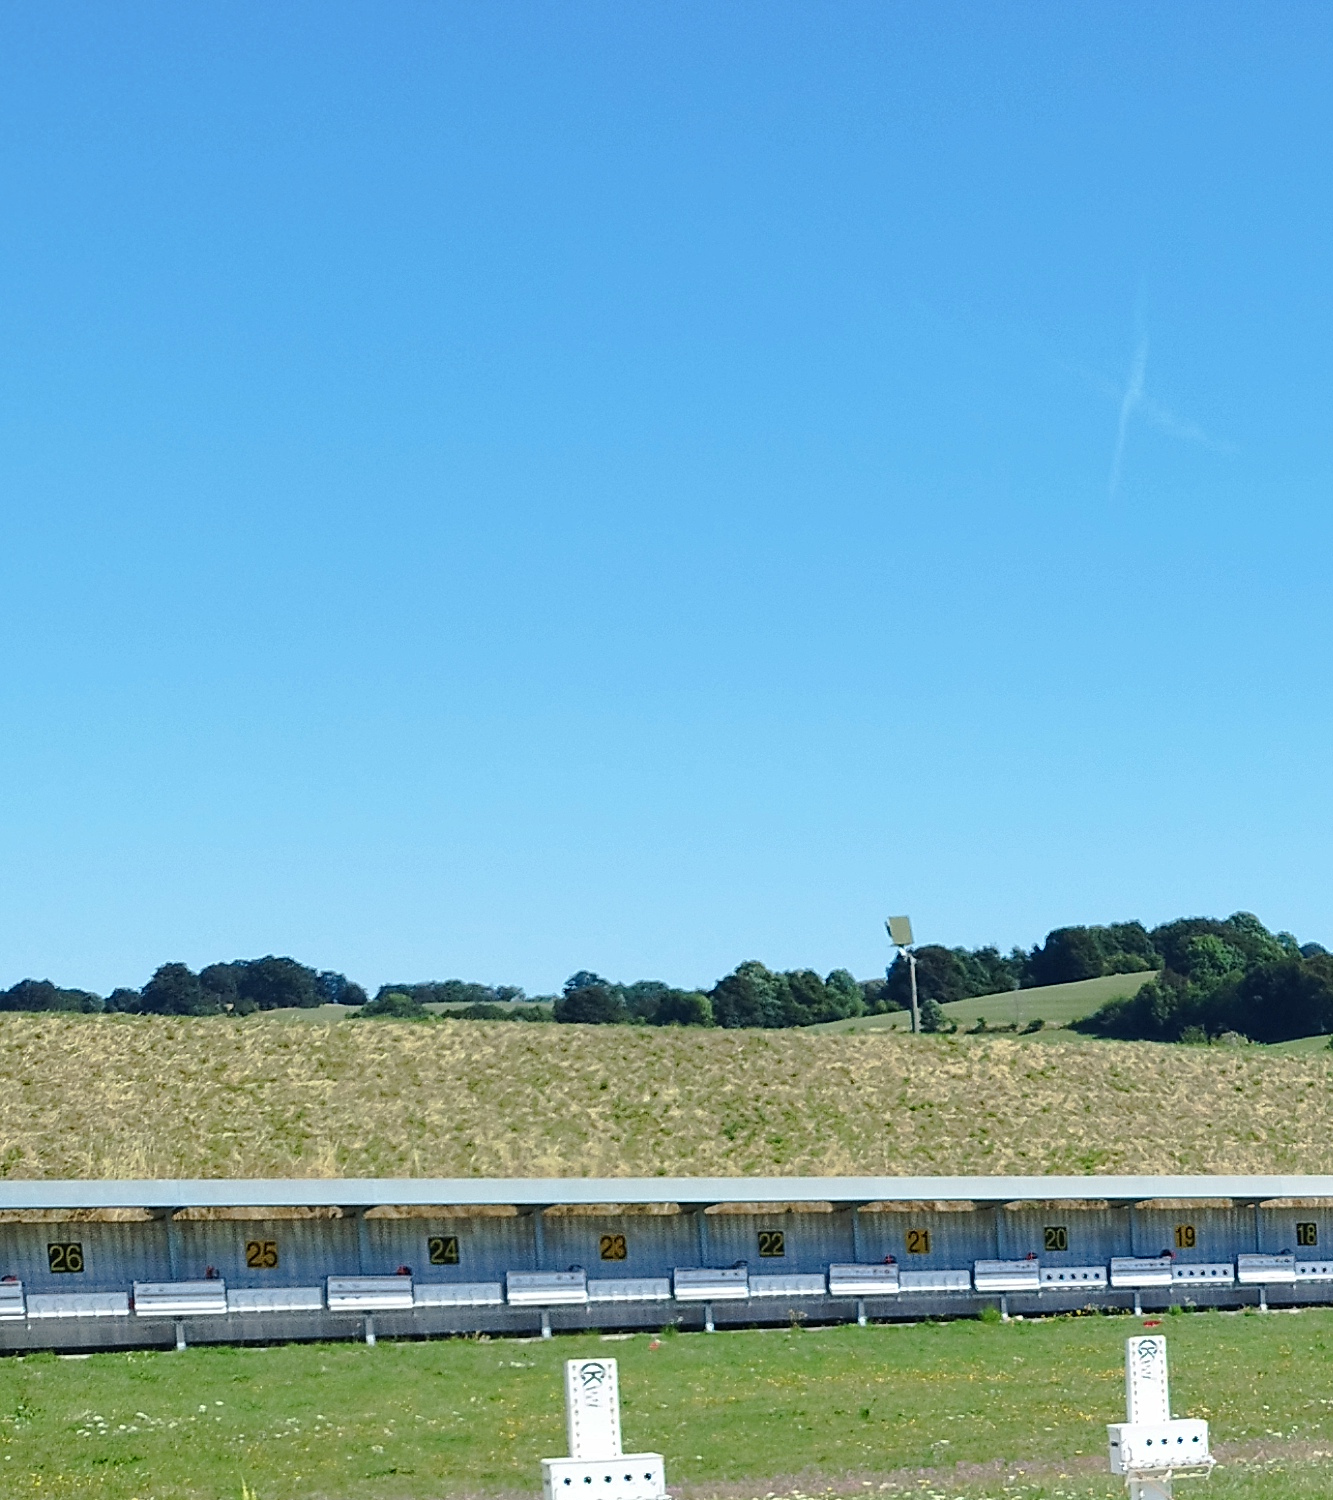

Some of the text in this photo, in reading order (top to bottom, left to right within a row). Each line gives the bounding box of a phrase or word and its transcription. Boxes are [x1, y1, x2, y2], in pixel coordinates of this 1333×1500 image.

[759, 1232, 784, 1255] 22
[908, 1231, 929, 1252] 21
[1045, 1228, 1067, 1249] 20
[1176, 1226, 1195, 1247] 19
[1297, 1224, 1316, 1244] 18
[49, 1245, 83, 1271] 26
[247, 1241, 278, 1268] 25
[429, 1238, 457, 1262] 24
[601, 1235, 627, 1259] 23
